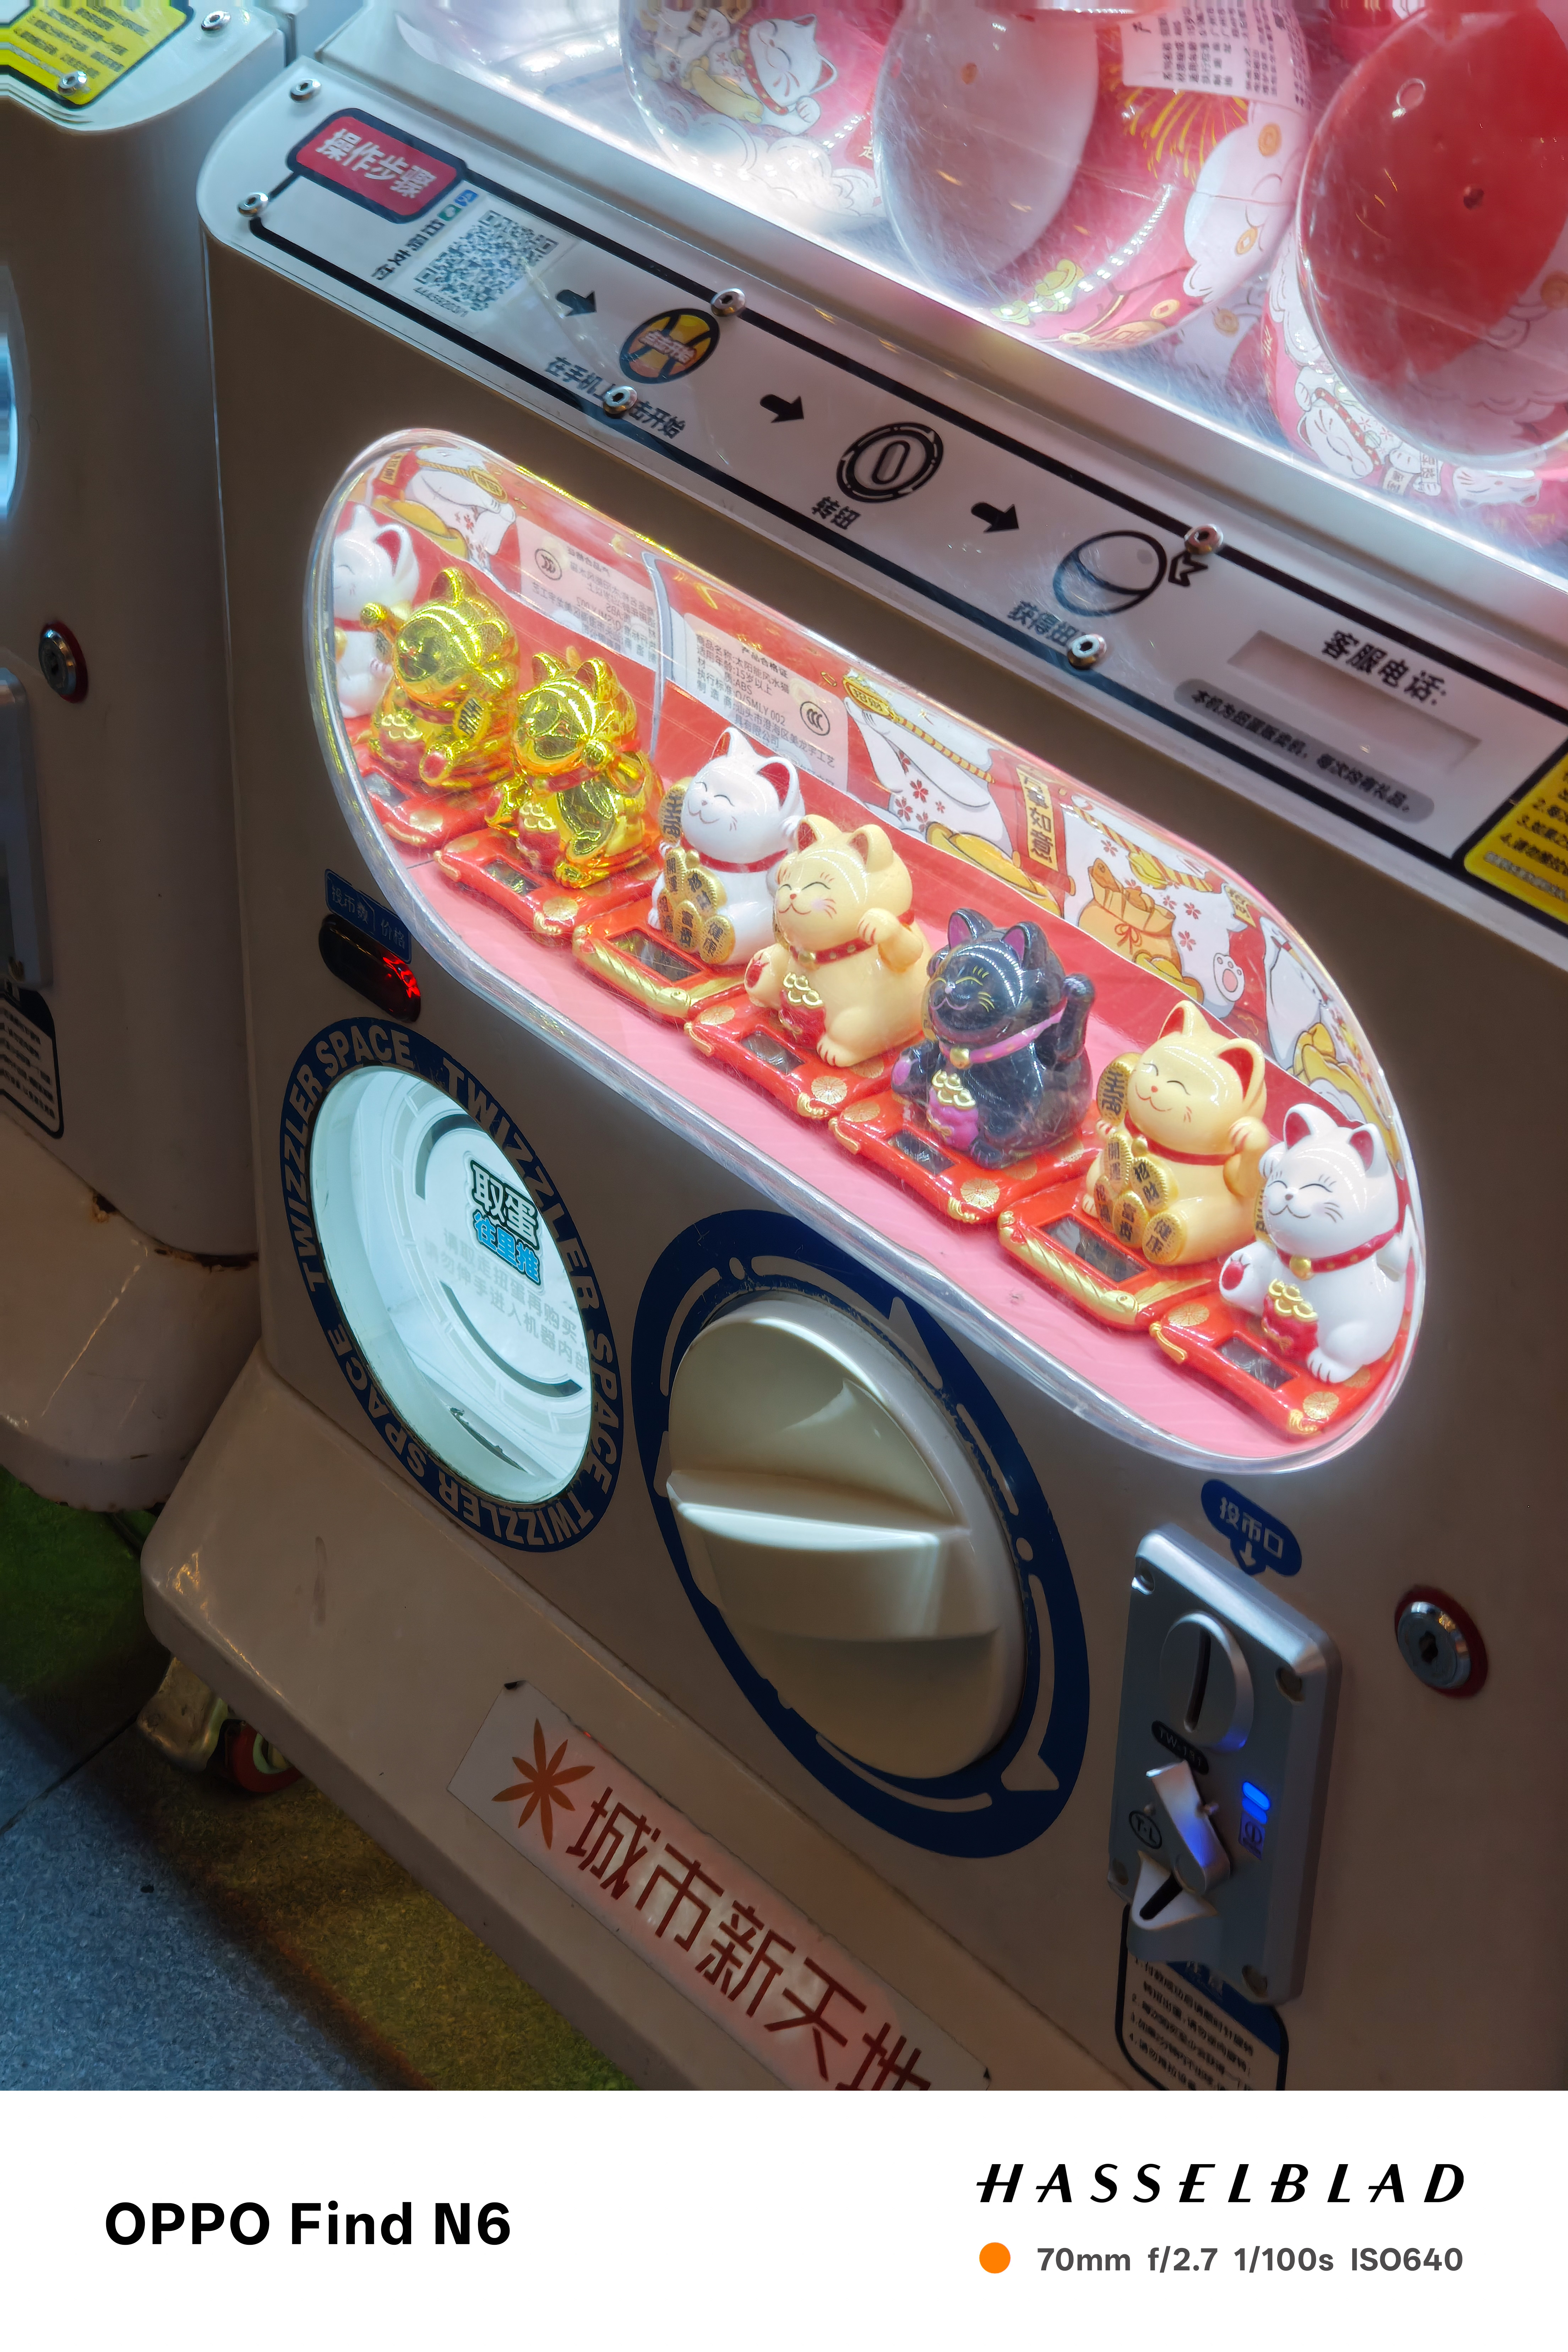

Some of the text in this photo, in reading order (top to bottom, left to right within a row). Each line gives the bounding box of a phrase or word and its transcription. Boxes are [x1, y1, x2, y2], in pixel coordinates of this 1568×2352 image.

[317, 129, 437, 198] 操作步骤
[545, 356, 686, 439] 在手机上击开始
[741, 647, 788, 679] 产品合格证
[284, 1025, 415, 1292] TWIZZLER SPACE
[473, 1164, 537, 1245] 取蛋
[442, 1057, 617, 1495] TWIZZLER SPACE
[474, 1212, 539, 1283] 往里推
[327, 1323, 594, 1546] TWIZZLER SPACE
[1219, 1496, 1284, 1559] 投币口
